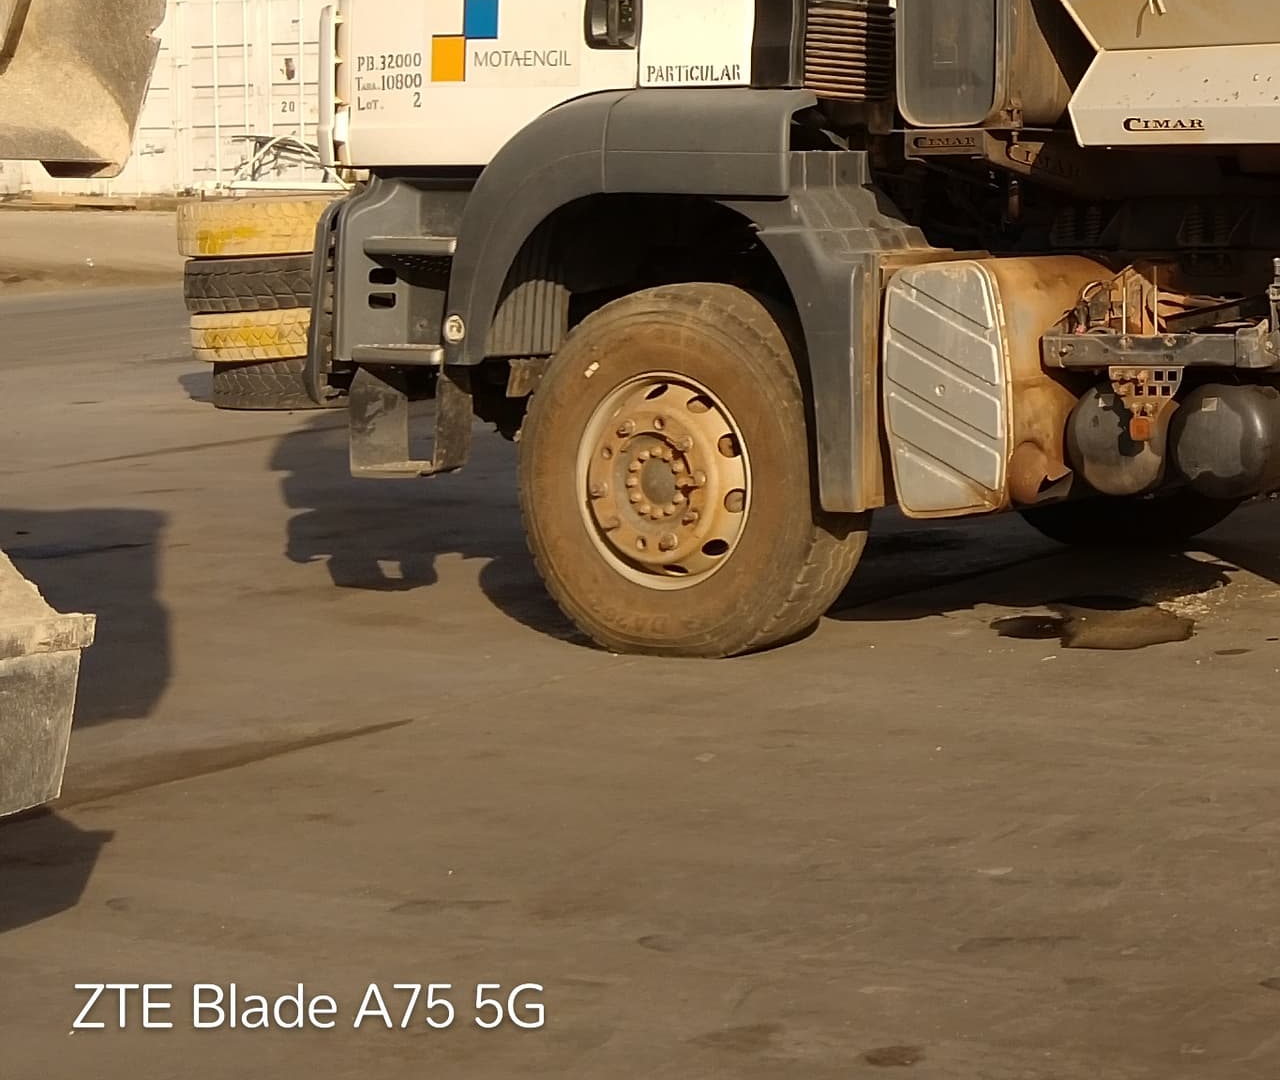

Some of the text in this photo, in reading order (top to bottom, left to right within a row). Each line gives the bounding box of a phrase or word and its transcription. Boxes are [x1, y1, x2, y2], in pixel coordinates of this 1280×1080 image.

[413, 91, 422, 108] 2
[281, 101, 295, 113] 20
[1123, 117, 1205, 131] CIMAR
[913, 136, 977, 149] CIMAR
